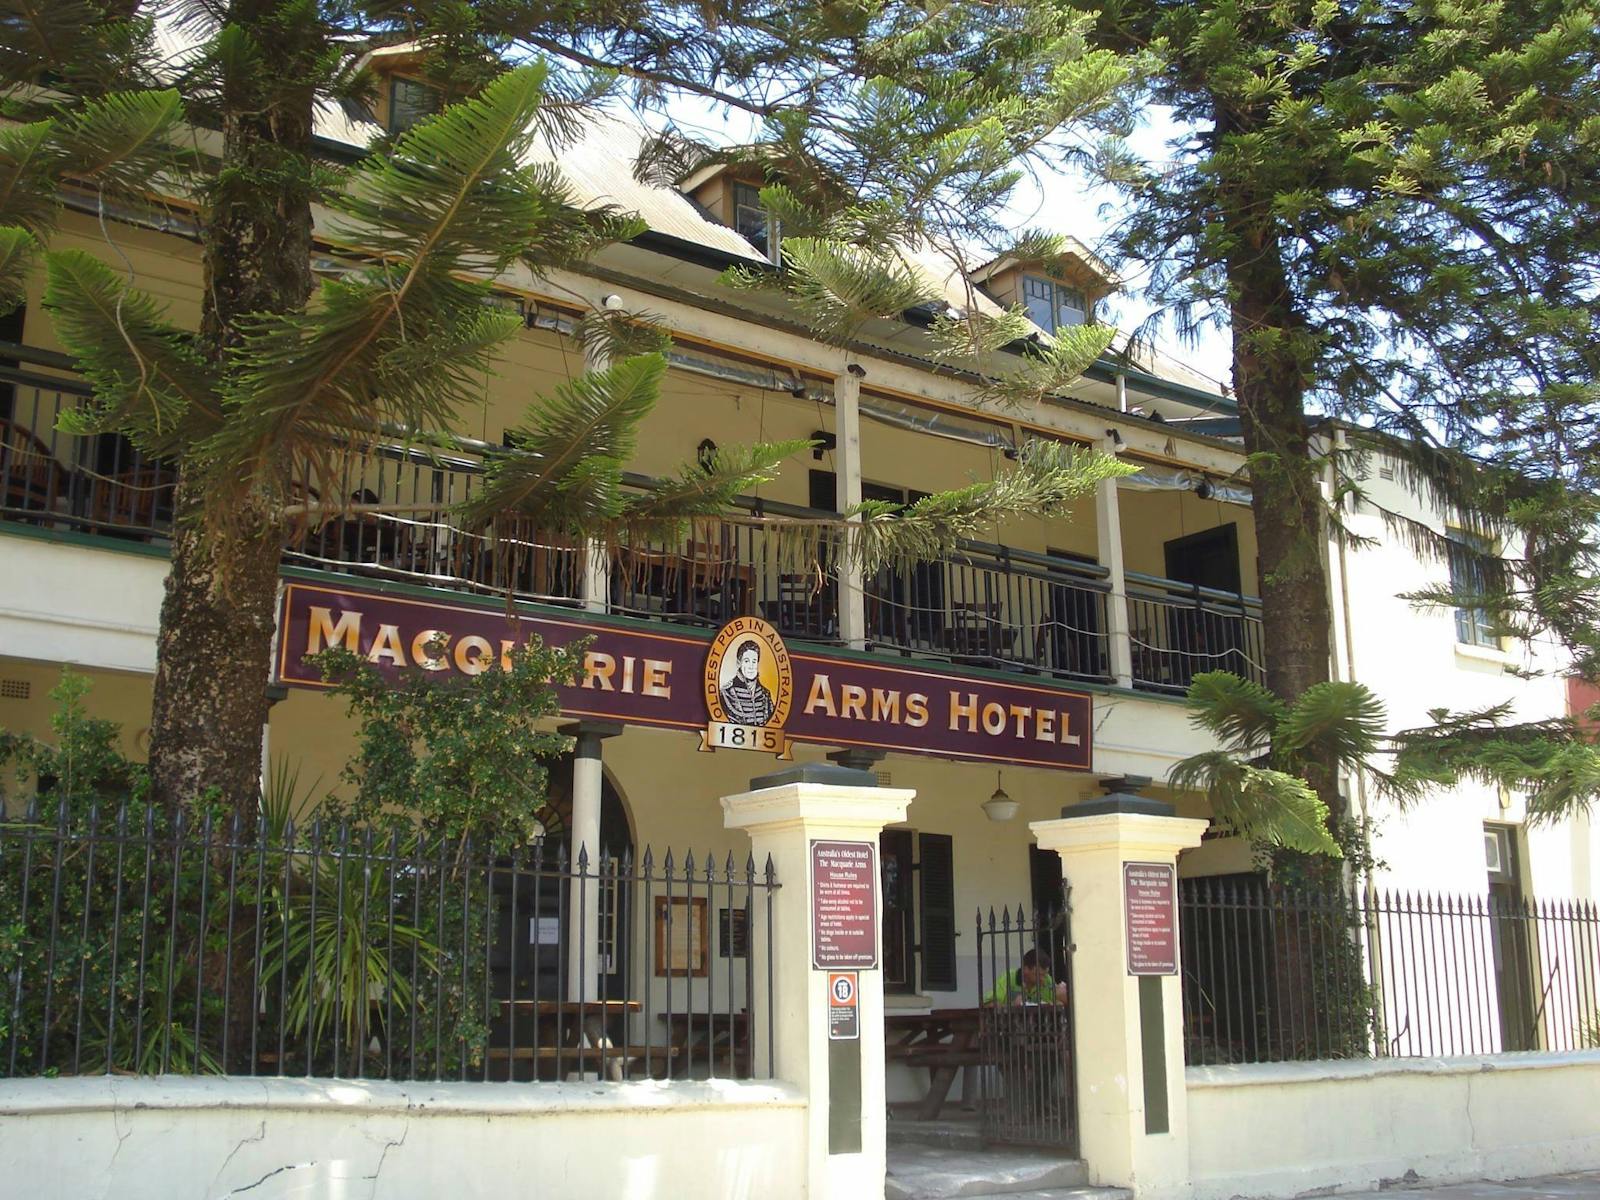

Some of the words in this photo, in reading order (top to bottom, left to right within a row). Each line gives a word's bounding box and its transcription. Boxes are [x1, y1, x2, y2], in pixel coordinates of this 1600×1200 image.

[306, 605, 673, 699] MACQRIE
[803, 674, 929, 728] ARMS
[949, 690, 1081, 748] HOTEL
[707, 649, 723, 719] OLDEST
[718, 620, 745, 647] PUB
[749, 618, 764, 633] IN
[766, 632, 790, 725] AUSTRALIA
[719, 726, 777, 749] 1815
[837, 986, 848, 998] 18
